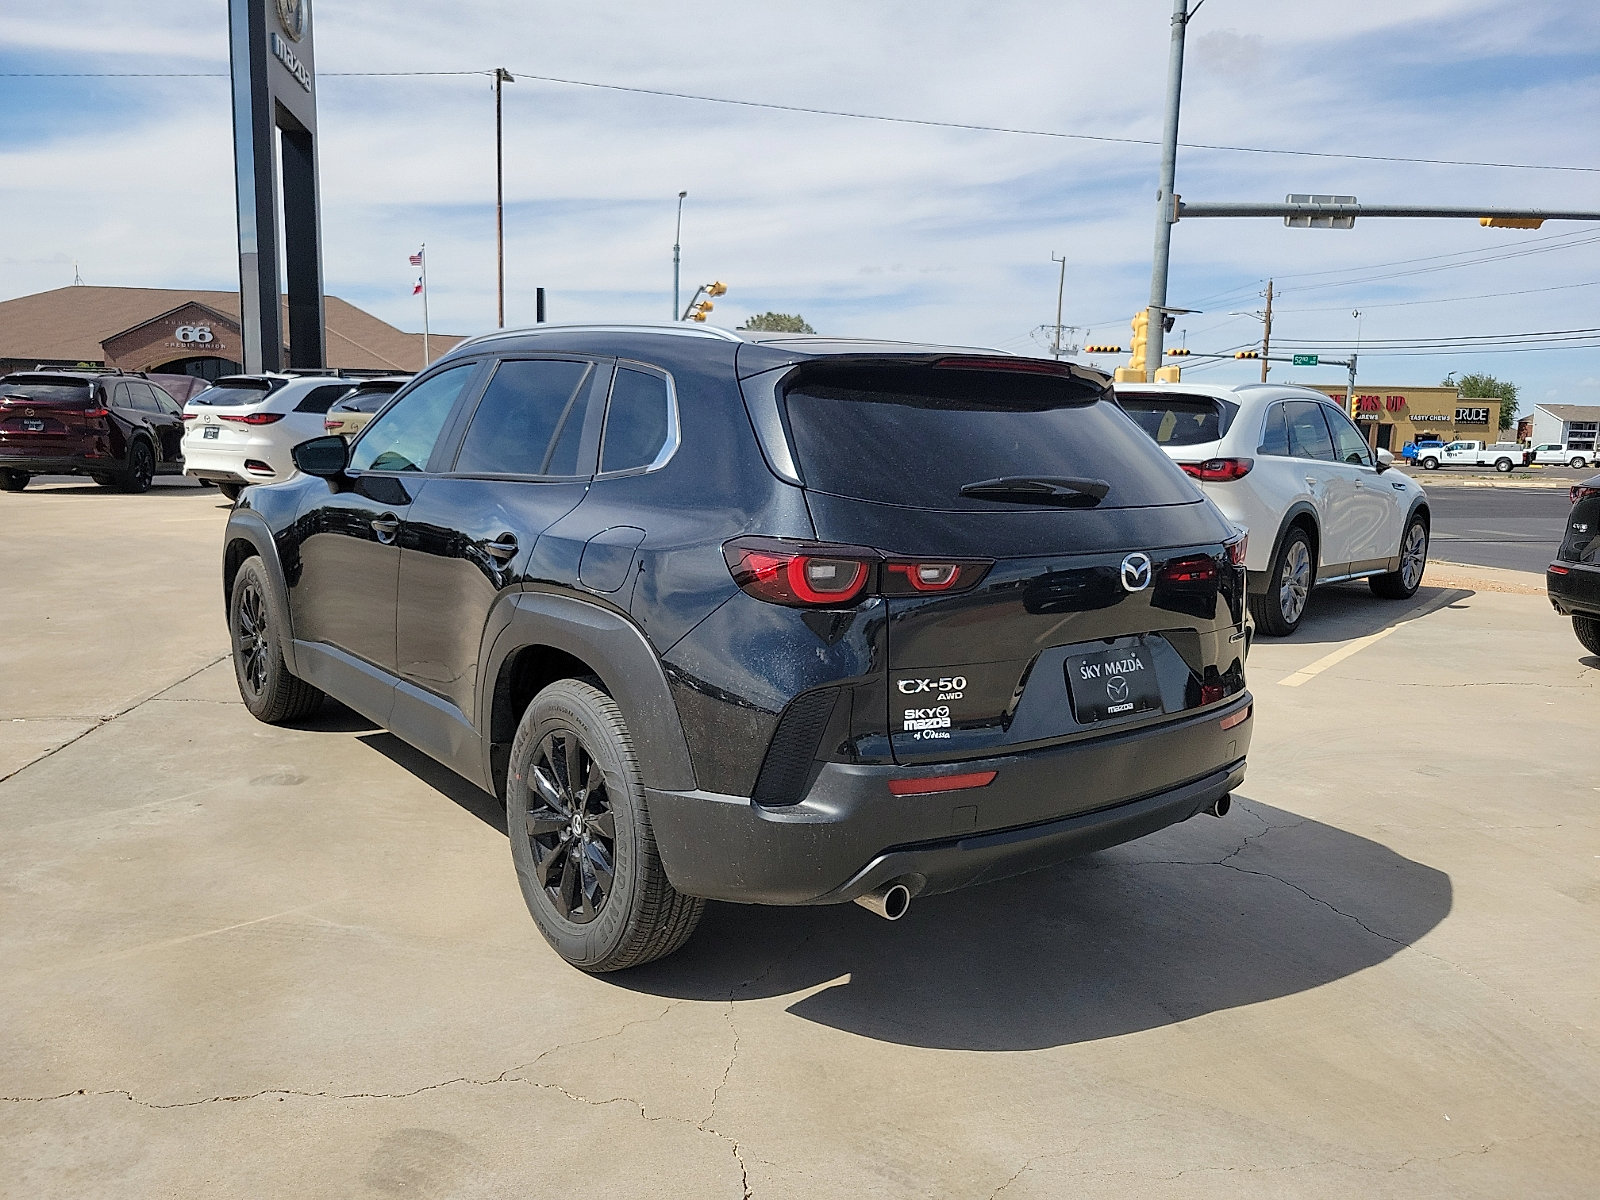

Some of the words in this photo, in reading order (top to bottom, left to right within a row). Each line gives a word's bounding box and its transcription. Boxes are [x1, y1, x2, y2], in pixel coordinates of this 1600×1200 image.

[175, 325, 214, 343] 66
[1386, 395, 1406, 412] UP
[1080, 664, 1101, 680] SKY
[1104, 658, 1145, 676] MAZDA
[897, 676, 967, 694] CX-50
[936, 692, 964, 701] AWD
[904, 707, 937, 720] SKY
[903, 717, 951, 731] mazda
